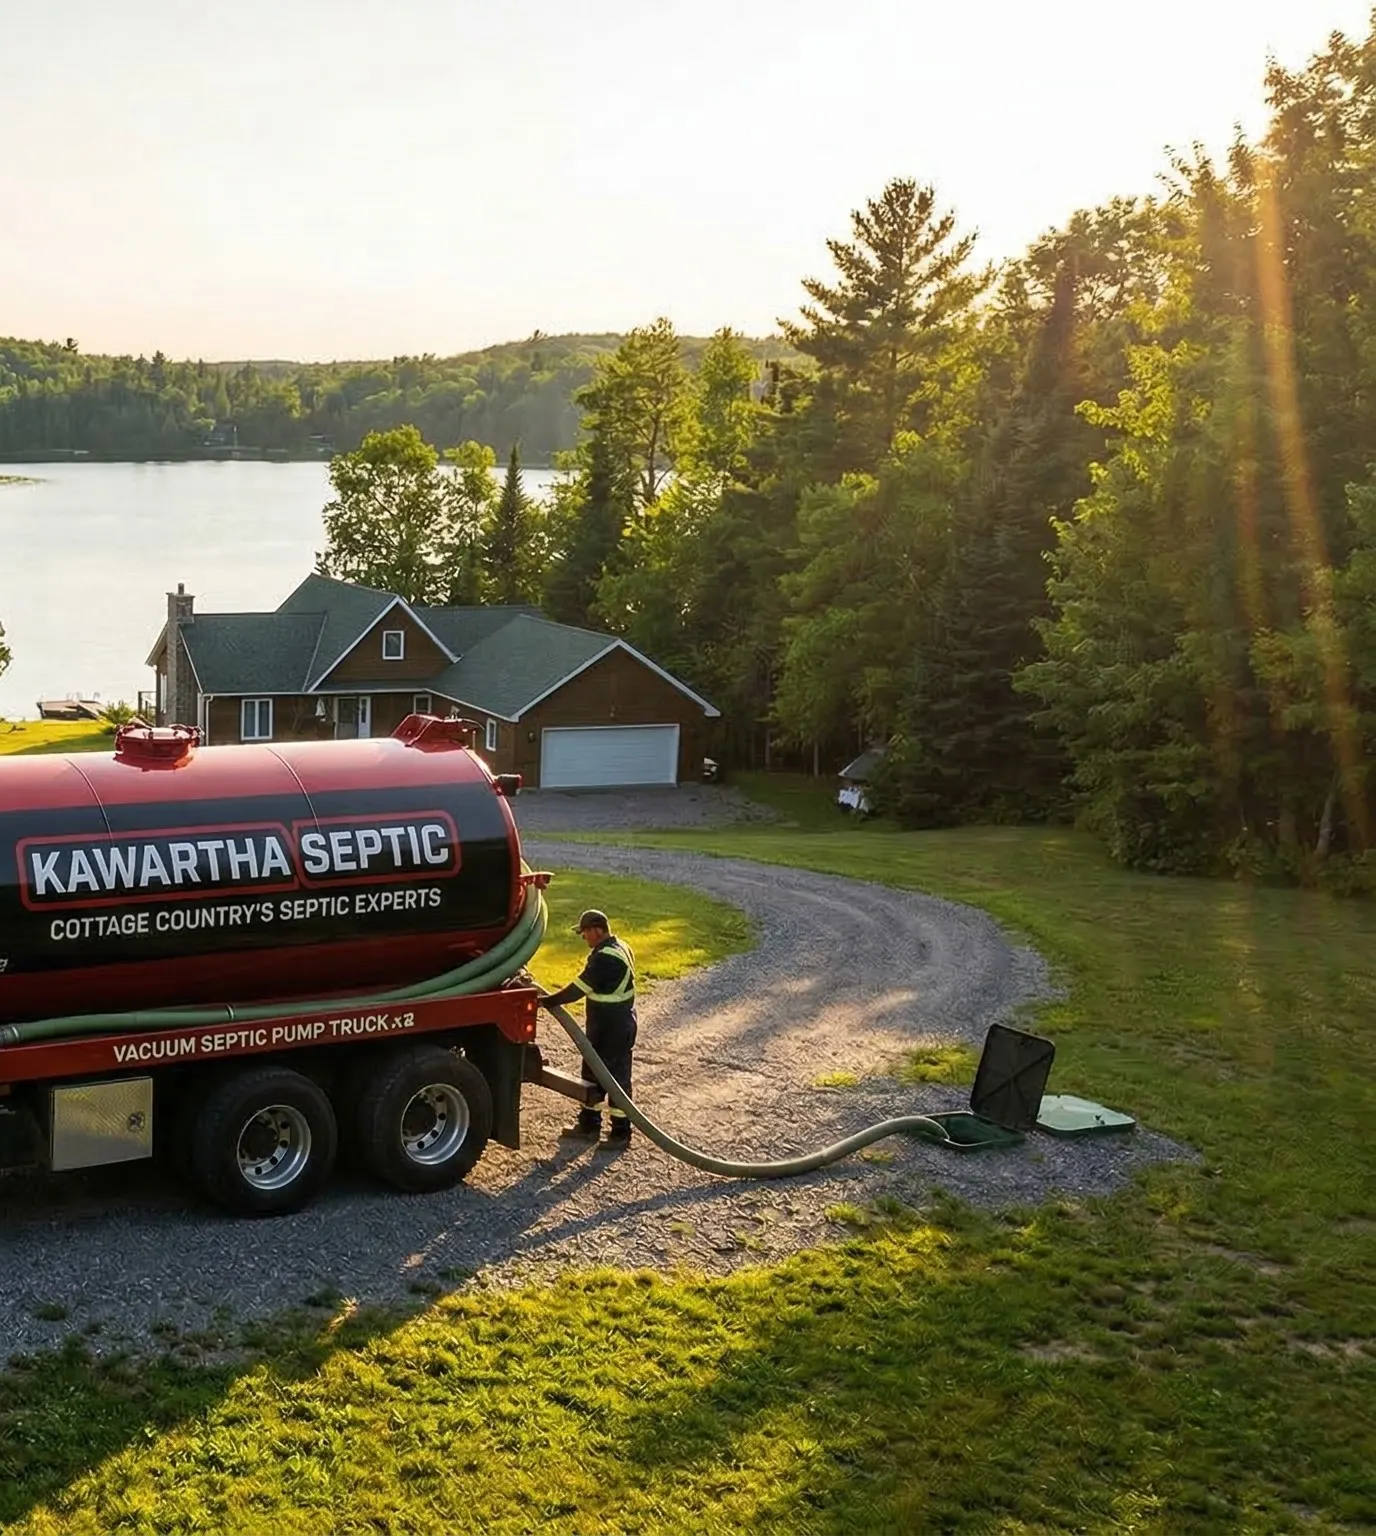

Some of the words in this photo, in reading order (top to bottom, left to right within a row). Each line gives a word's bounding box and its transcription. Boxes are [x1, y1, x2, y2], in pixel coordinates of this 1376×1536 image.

[31, 836, 291, 895] KAWARTHA
[300, 824, 449, 875] SEPTIC
[50, 911, 150, 941] COTTAGE
[155, 902, 275, 933] COUNTRY'S
[279, 896, 351, 922] SEPTIC
[355, 887, 442, 914] EXPERTS
[113, 1038, 196, 1063] VACUUM
[200, 1028, 268, 1053] SEPTIC
[271, 1021, 325, 1043] PUMP
[328, 1013, 389, 1036] TRUCK
